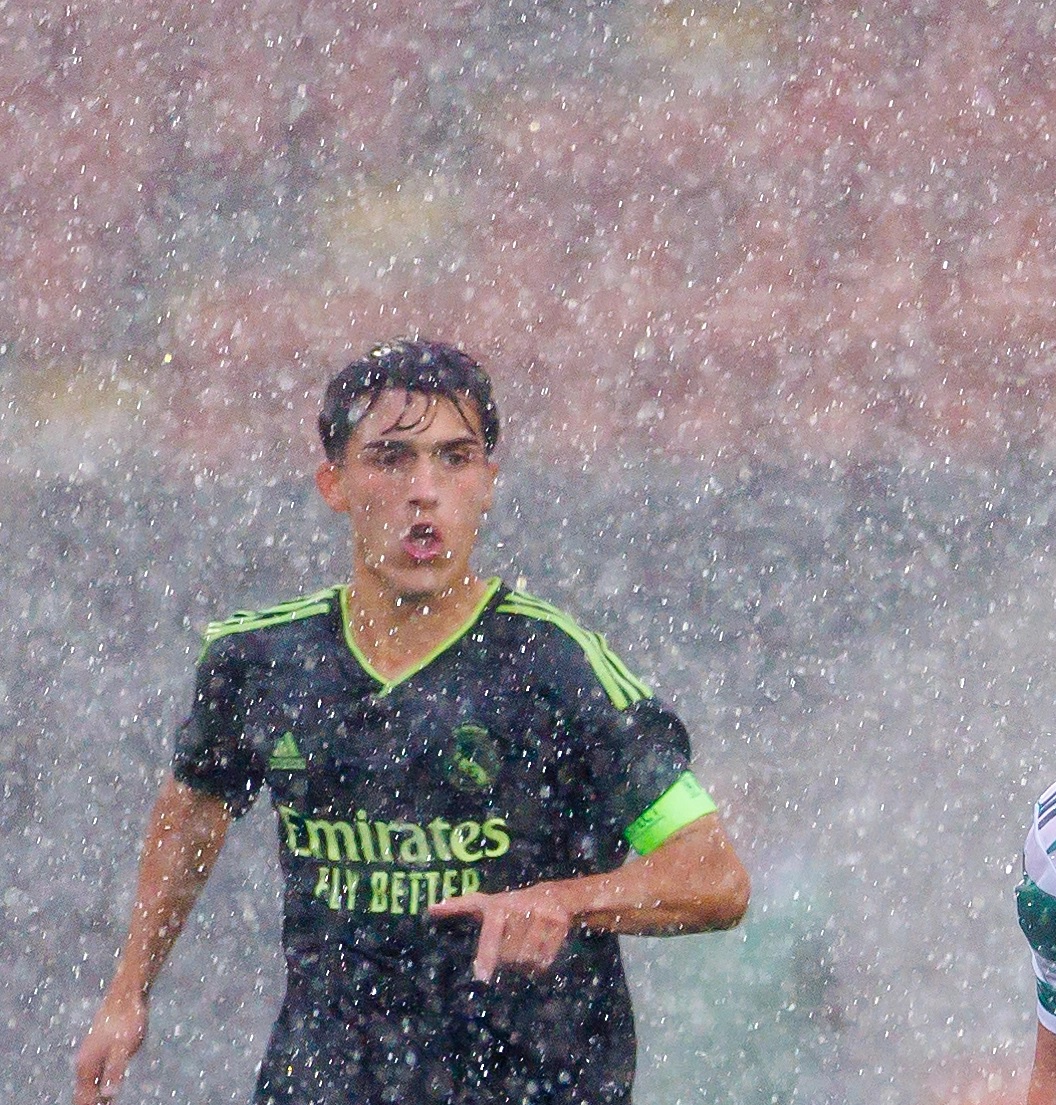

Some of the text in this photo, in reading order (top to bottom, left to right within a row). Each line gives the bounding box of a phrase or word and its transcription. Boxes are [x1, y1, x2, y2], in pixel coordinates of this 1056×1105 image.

[278, 809, 511, 863] Emirates
[313, 866, 480, 916] FLY BETTER
